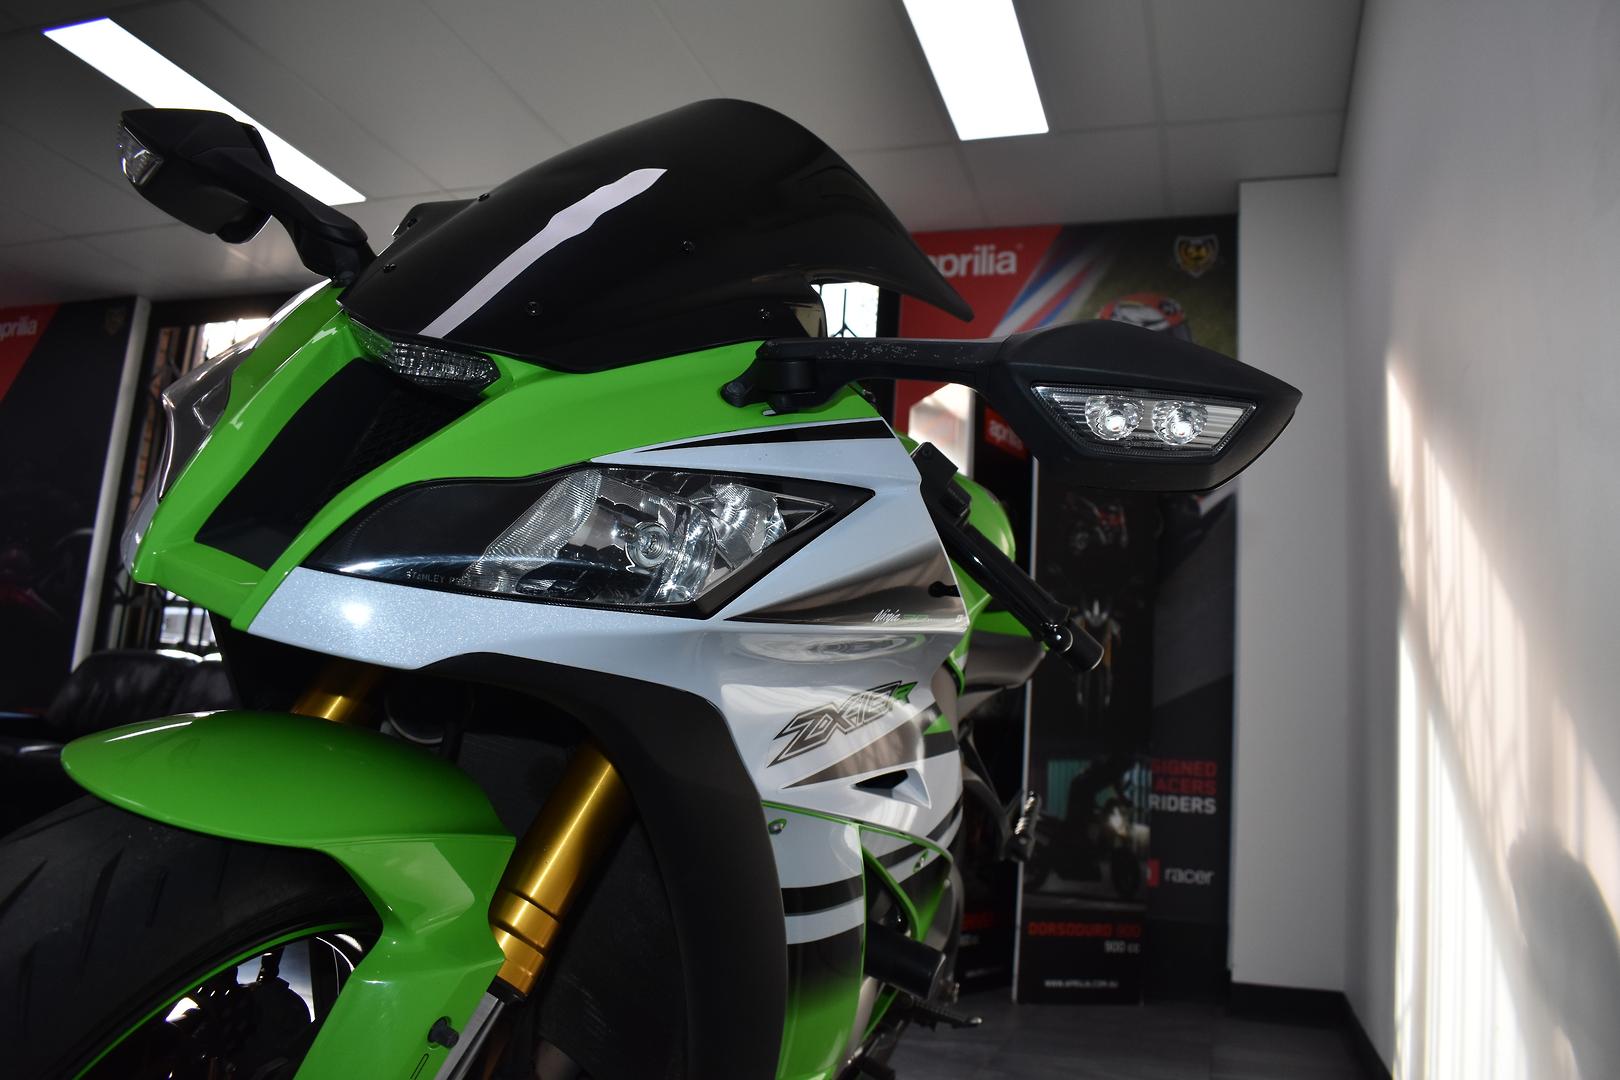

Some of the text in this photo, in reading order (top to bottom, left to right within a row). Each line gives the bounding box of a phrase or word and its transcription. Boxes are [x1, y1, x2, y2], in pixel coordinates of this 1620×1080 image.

[928, 245, 1017, 278] prilia
[0, 315, 38, 341] prilia
[872, 608, 901, 625] Ninja
[1148, 793, 1217, 815] RIDERS
[1164, 867, 1215, 886] racer
[1027, 921, 1112, 938] DORSODURO
